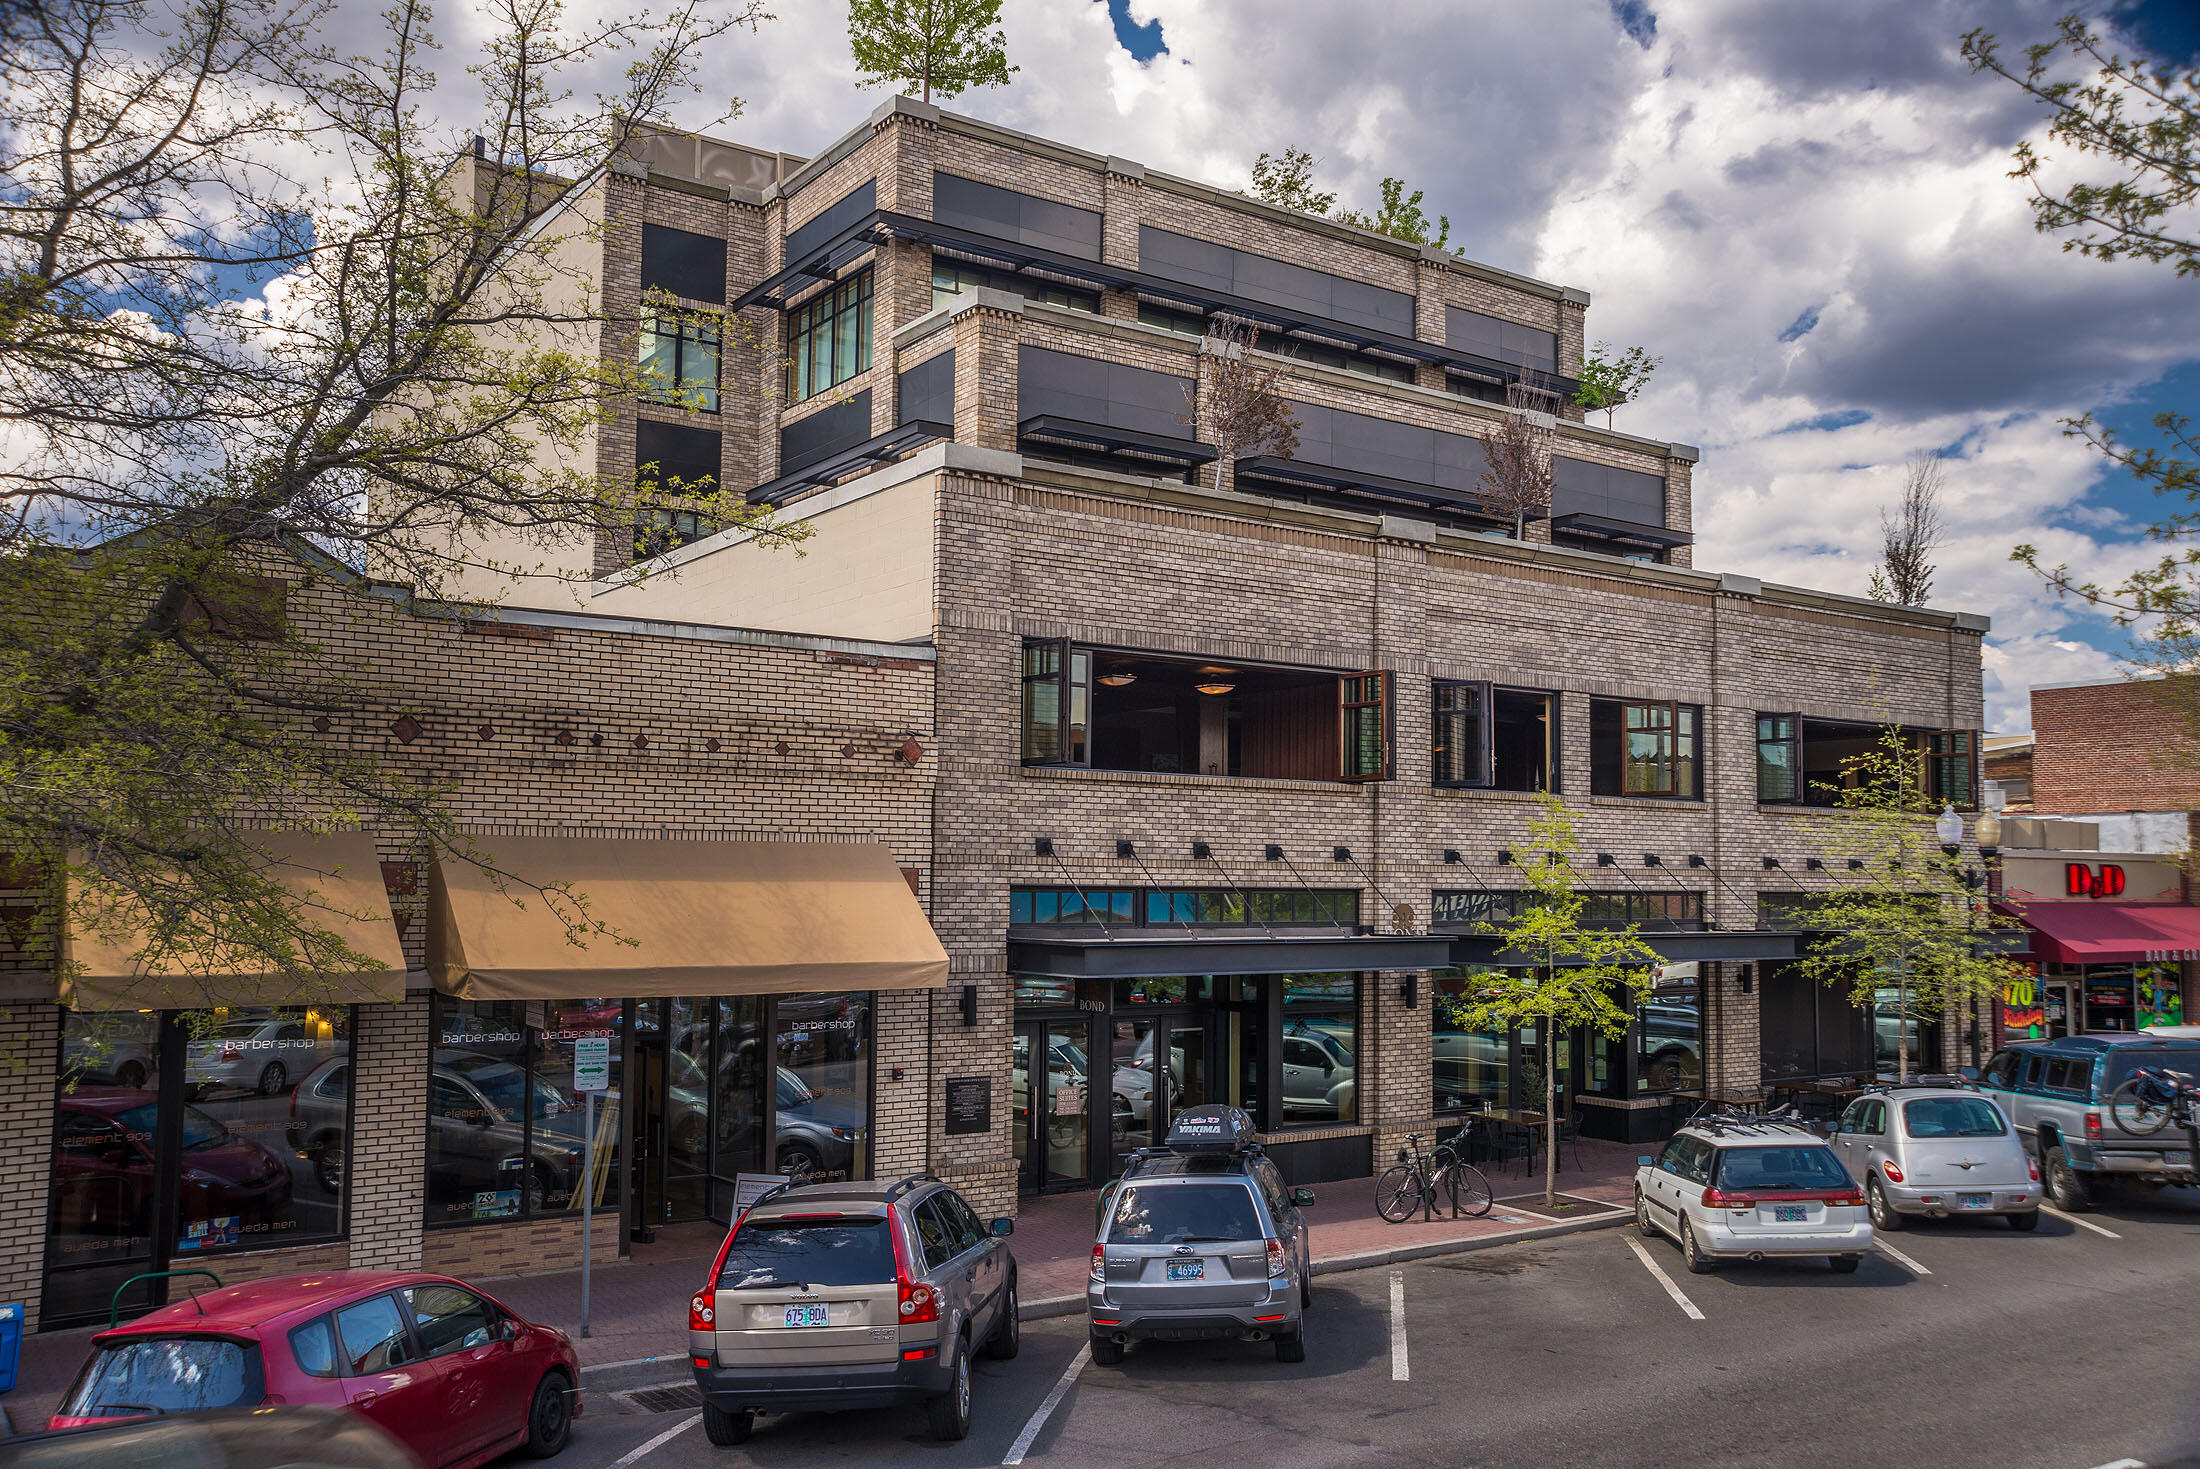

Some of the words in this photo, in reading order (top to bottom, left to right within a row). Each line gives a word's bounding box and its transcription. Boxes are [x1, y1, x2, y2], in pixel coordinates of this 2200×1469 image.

[2145, 950, 2167, 961] BAR
[2172, 950, 2179, 961] &
[2009, 980, 2033, 1006] 70
[1079, 999, 1105, 1012] BOND
[791, 1020, 855, 1030] barbershop
[442, 1031, 520, 1044] barbershop
[225, 1038, 315, 1051] barbershop
[444, 1109, 489, 1120] element
[1179, 1125, 1221, 1134] YAKIMA
[62, 1133, 123, 1146] element
[126, 1131, 152, 1142] 909
[828, 1169, 846, 1177] men
[273, 1219, 297, 1230] men
[64, 1238, 109, 1252] aveda
[113, 1236, 140, 1247] men
[1177, 1264, 1203, 1276] 46995
[786, 1309, 803, 1322] 675
[809, 1308, 827, 1321] BDA
